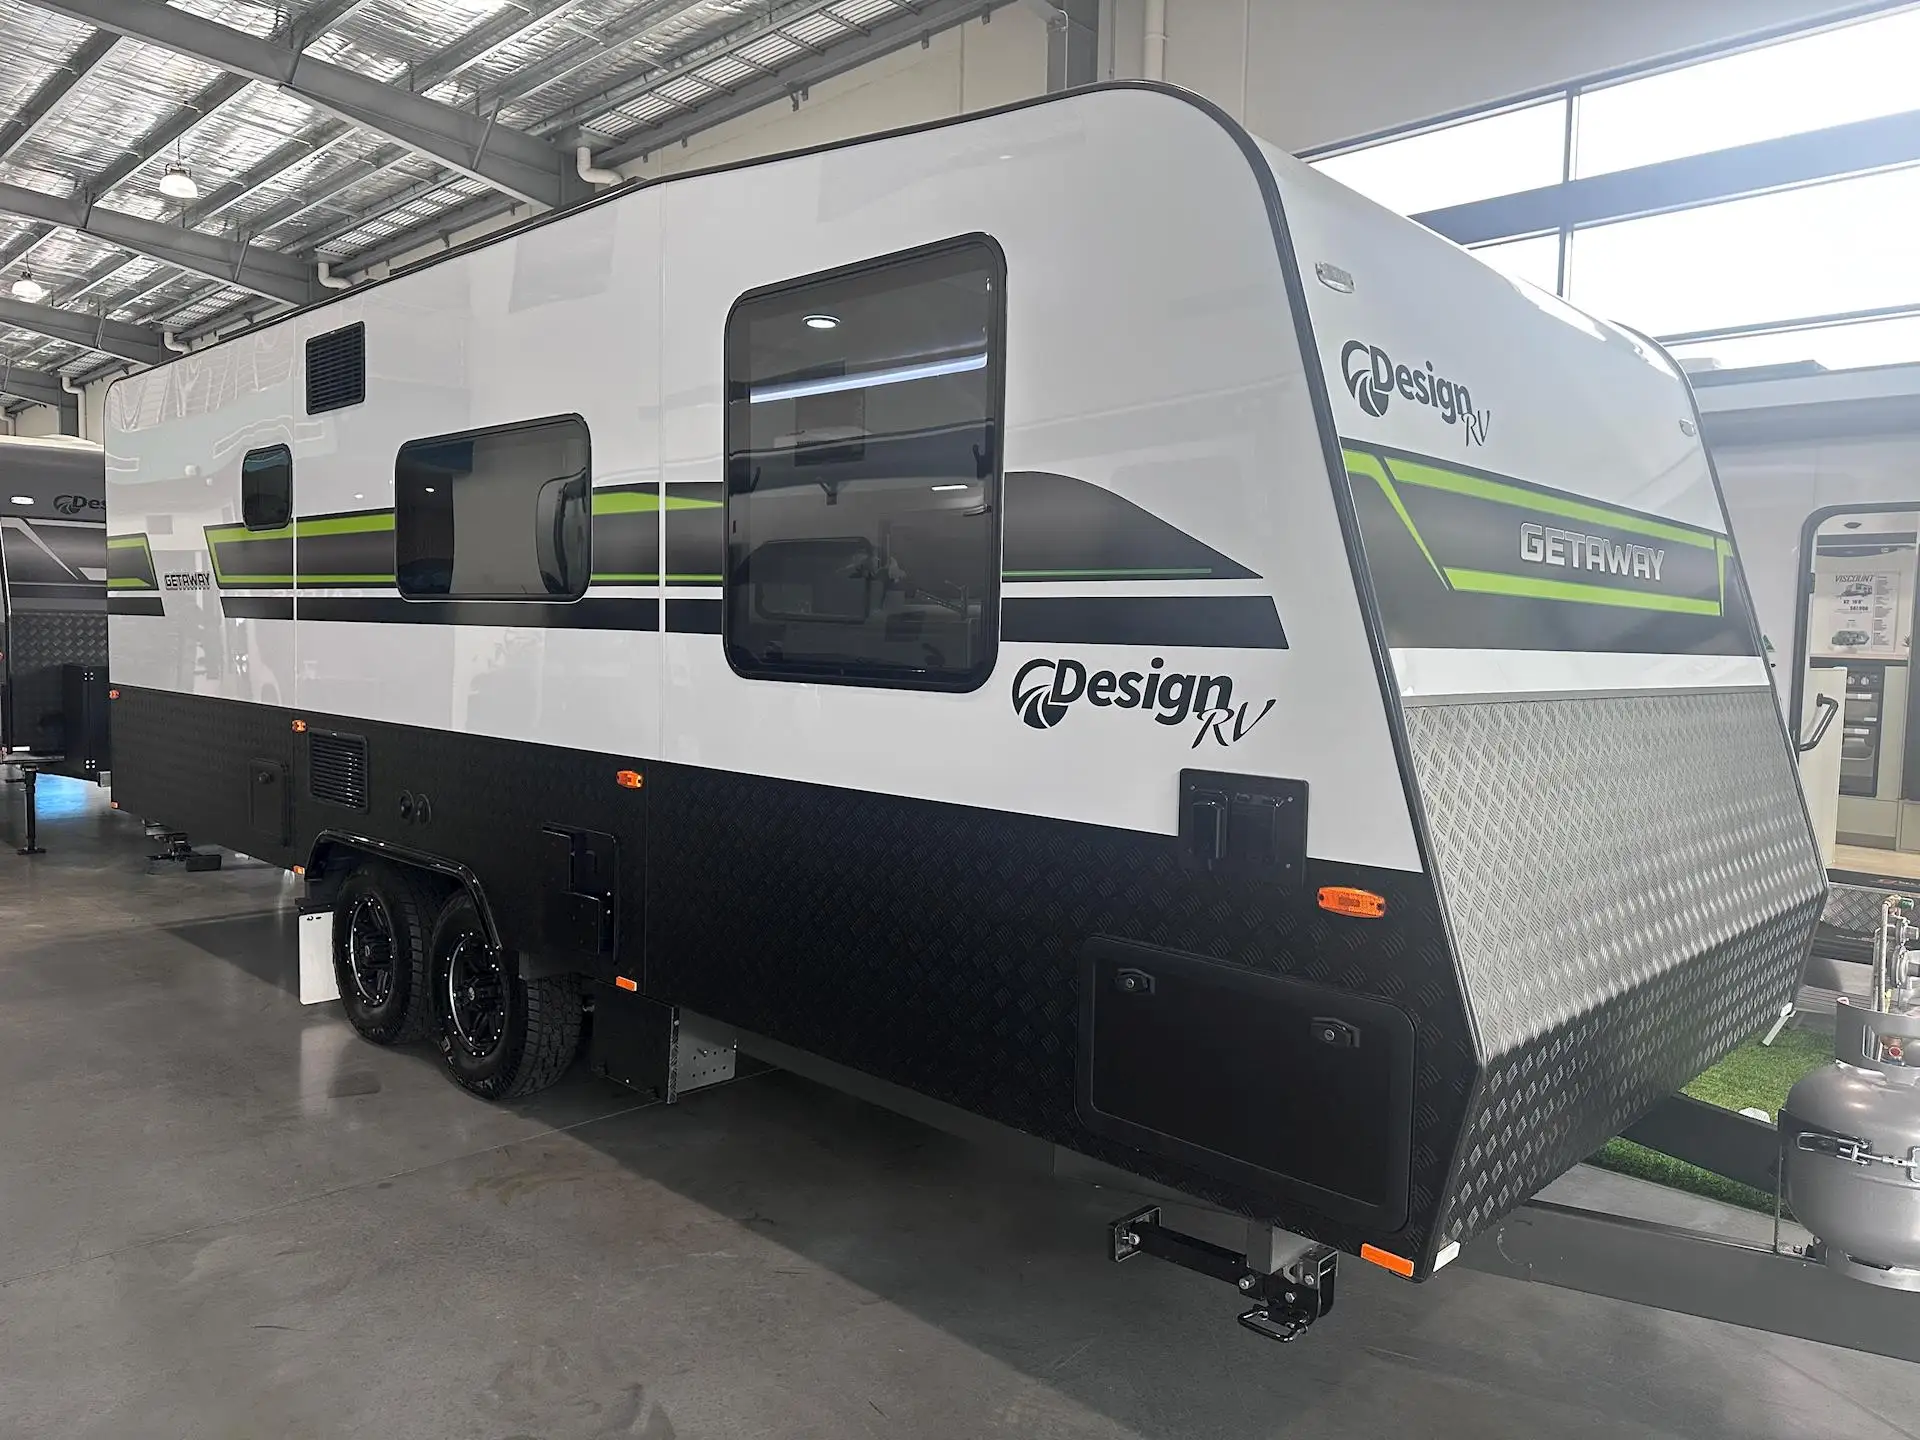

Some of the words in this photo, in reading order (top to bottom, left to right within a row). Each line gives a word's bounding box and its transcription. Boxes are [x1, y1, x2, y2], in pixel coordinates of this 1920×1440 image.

[1369, 345, 1473, 424] Design
[1461, 410, 1491, 447] RV
[1520, 522, 1665, 581] GETAWAY
[164, 573, 210, 588] GETAWAY
[1050, 657, 1233, 726] Design
[1191, 699, 1277, 750] RV
